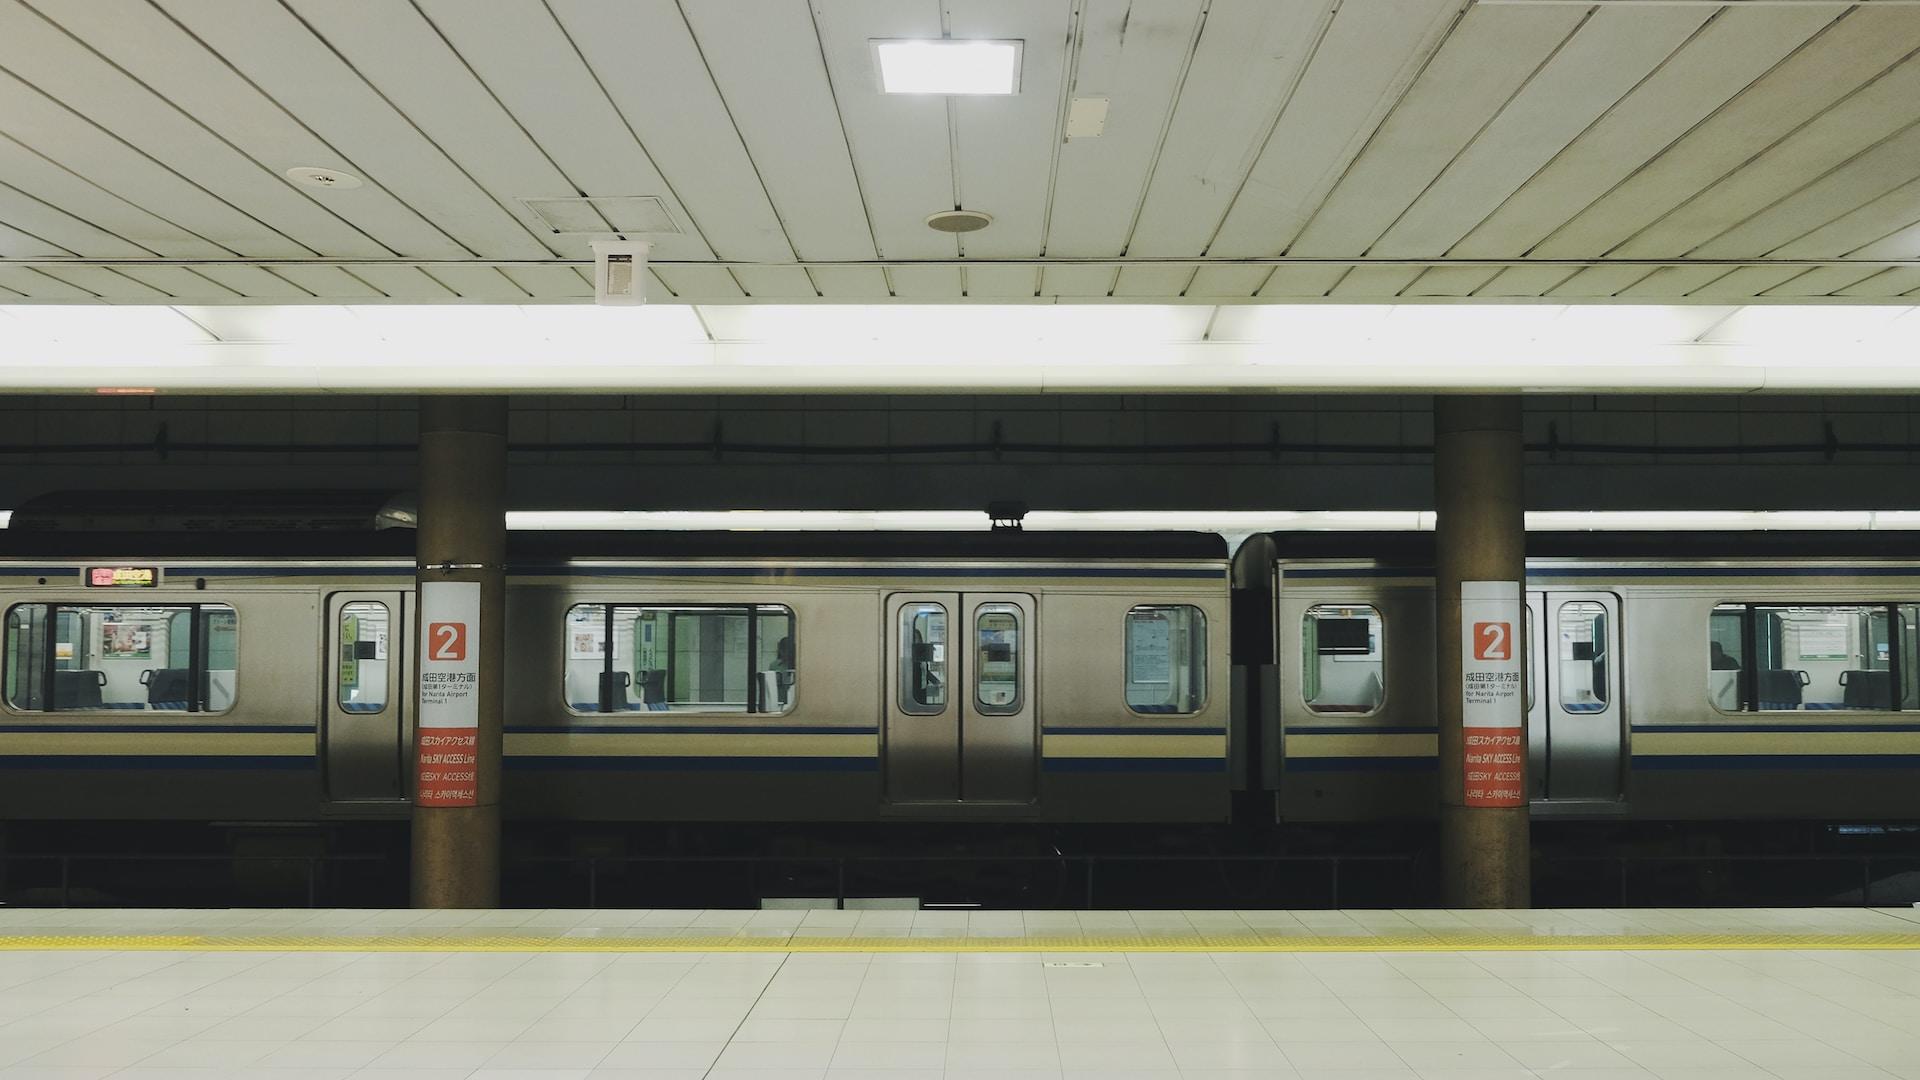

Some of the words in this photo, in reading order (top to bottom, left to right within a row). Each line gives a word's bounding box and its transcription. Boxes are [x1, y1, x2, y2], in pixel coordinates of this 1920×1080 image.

[436, 625, 458, 659] 2
[1483, 624, 1504, 658] 2
[422, 672, 476, 682] 成田空港方面
[1465, 672, 1519, 682] 成田空港方面
[432, 753, 444, 764] SKY
[442, 753, 464, 764] ACCESS
[1482, 753, 1494, 764] SKY
[1493, 753, 1512, 764] ACCESS
